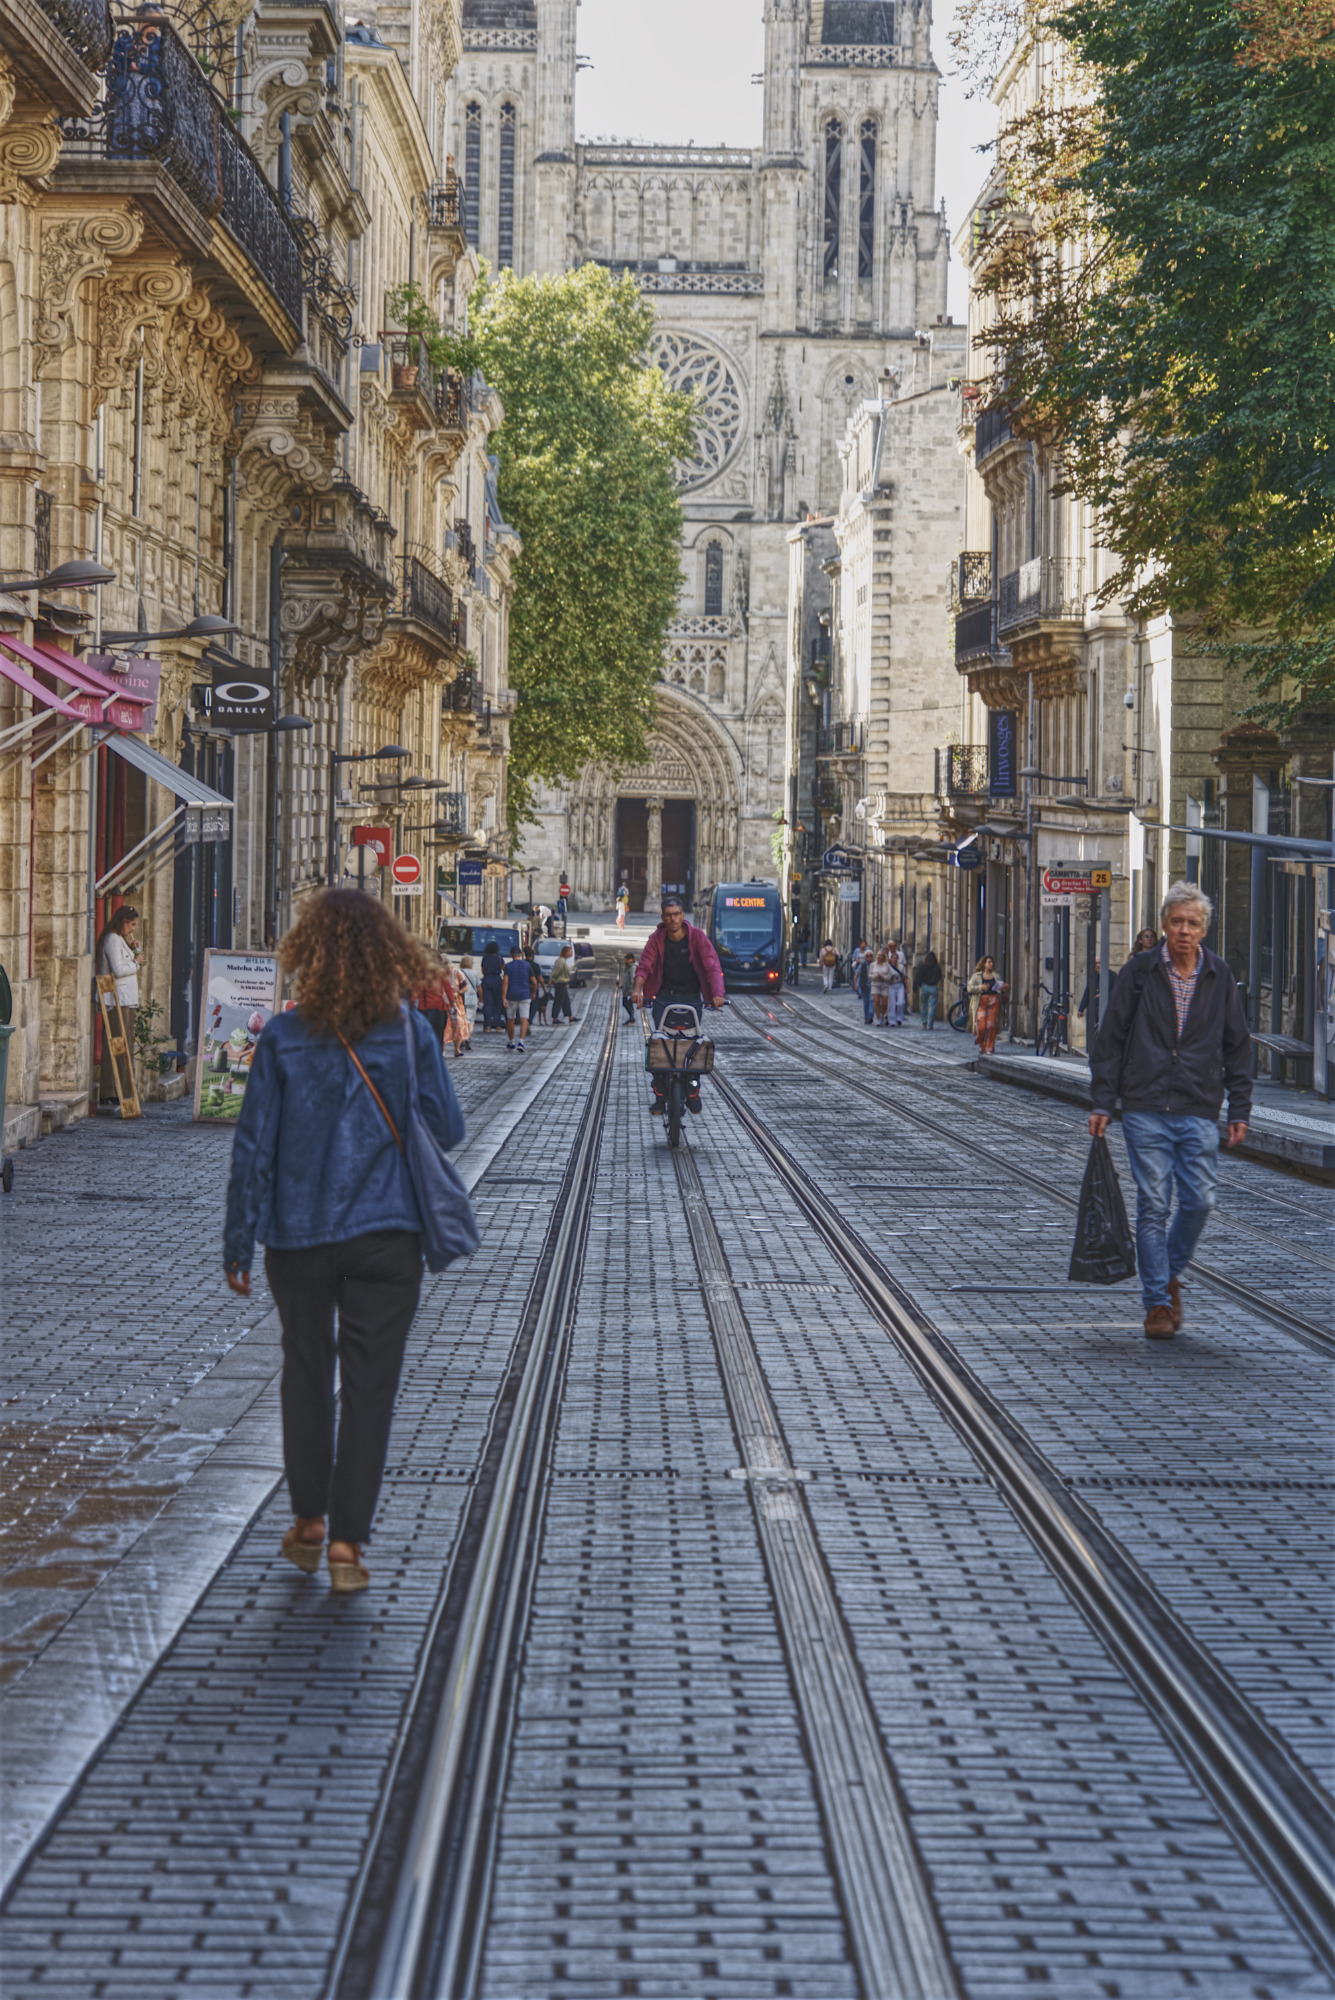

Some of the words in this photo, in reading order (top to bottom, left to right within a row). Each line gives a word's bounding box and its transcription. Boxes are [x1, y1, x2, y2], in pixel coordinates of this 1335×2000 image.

[994, 715, 1012, 787] linvosges
[1096, 874, 1106, 883] 25
[741, 898, 766, 907] CENTRE
